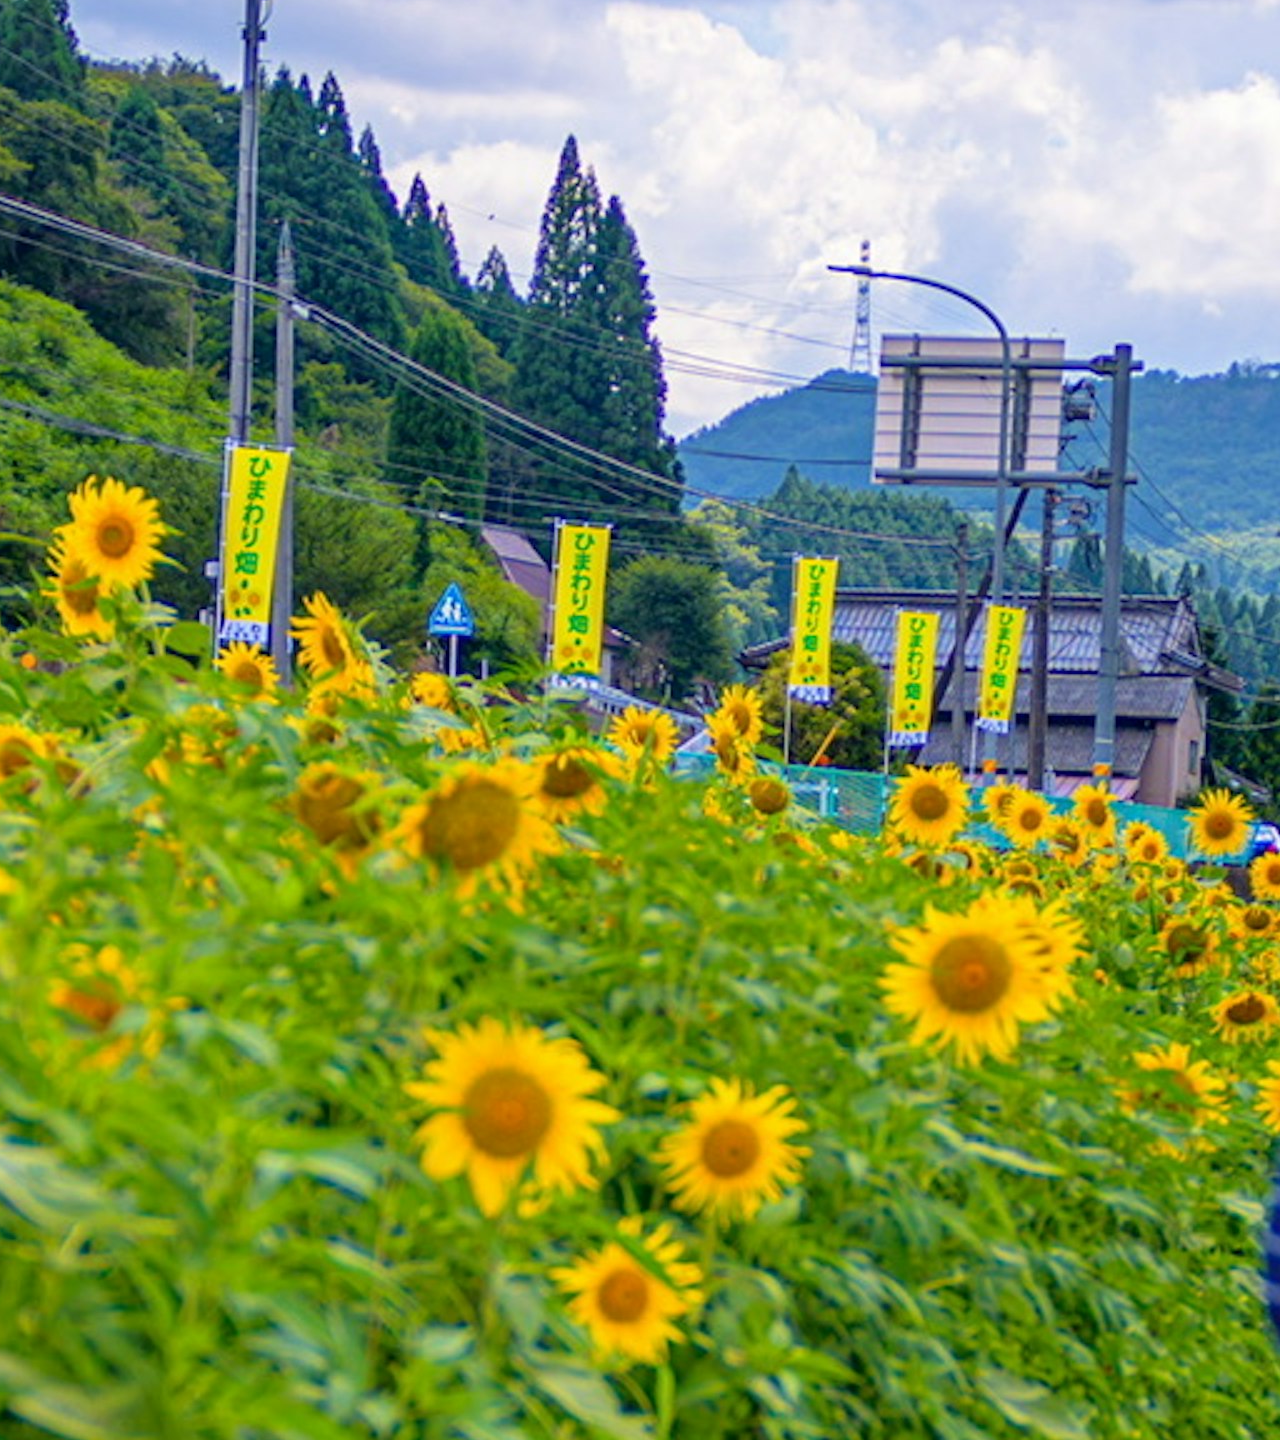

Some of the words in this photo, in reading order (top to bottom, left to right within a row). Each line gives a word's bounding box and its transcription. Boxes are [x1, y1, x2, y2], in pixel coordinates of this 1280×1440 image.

[234, 457, 272, 575] ひまわり畑
[567, 532, 596, 635] ひまわり畑
